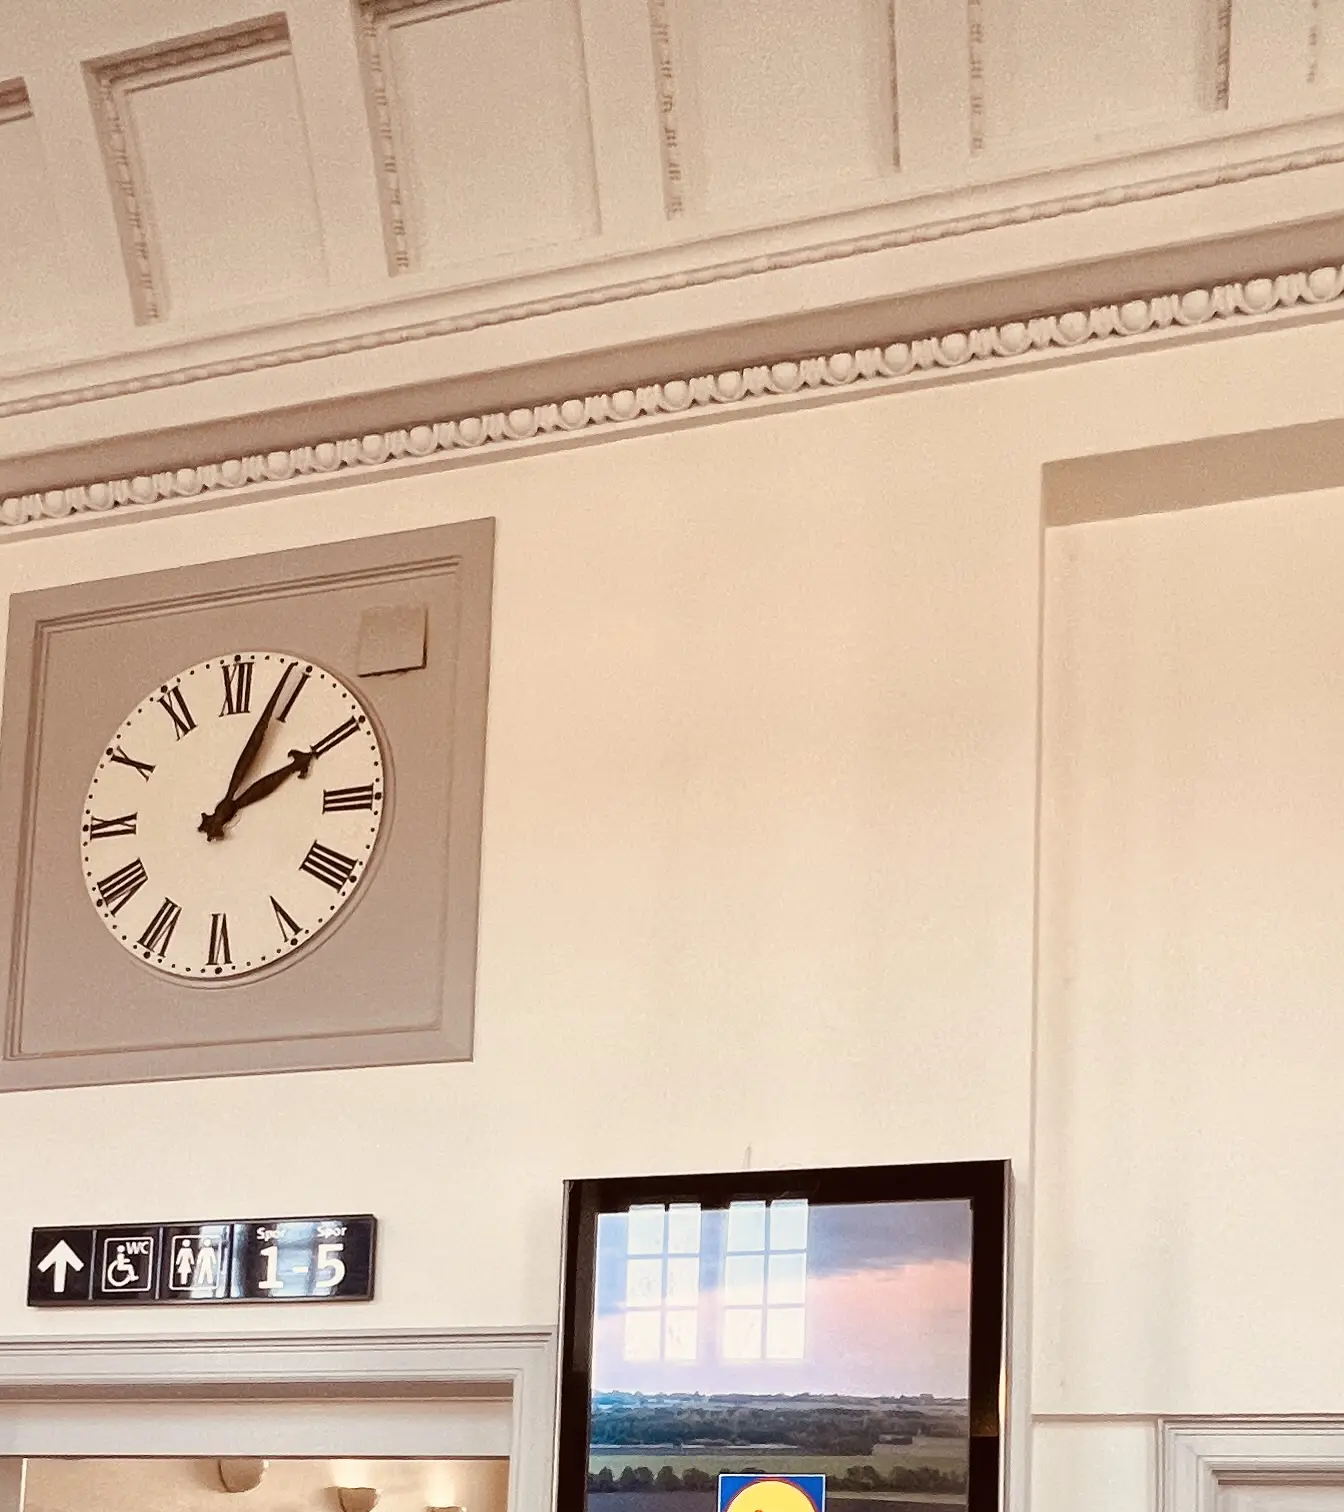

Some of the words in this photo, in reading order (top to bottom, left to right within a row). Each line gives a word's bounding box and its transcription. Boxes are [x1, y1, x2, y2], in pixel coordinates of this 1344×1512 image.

[321, 782, 375, 815] III
[317, 1224, 347, 1240] Spor
[126, 1241, 149, 1255] WC
